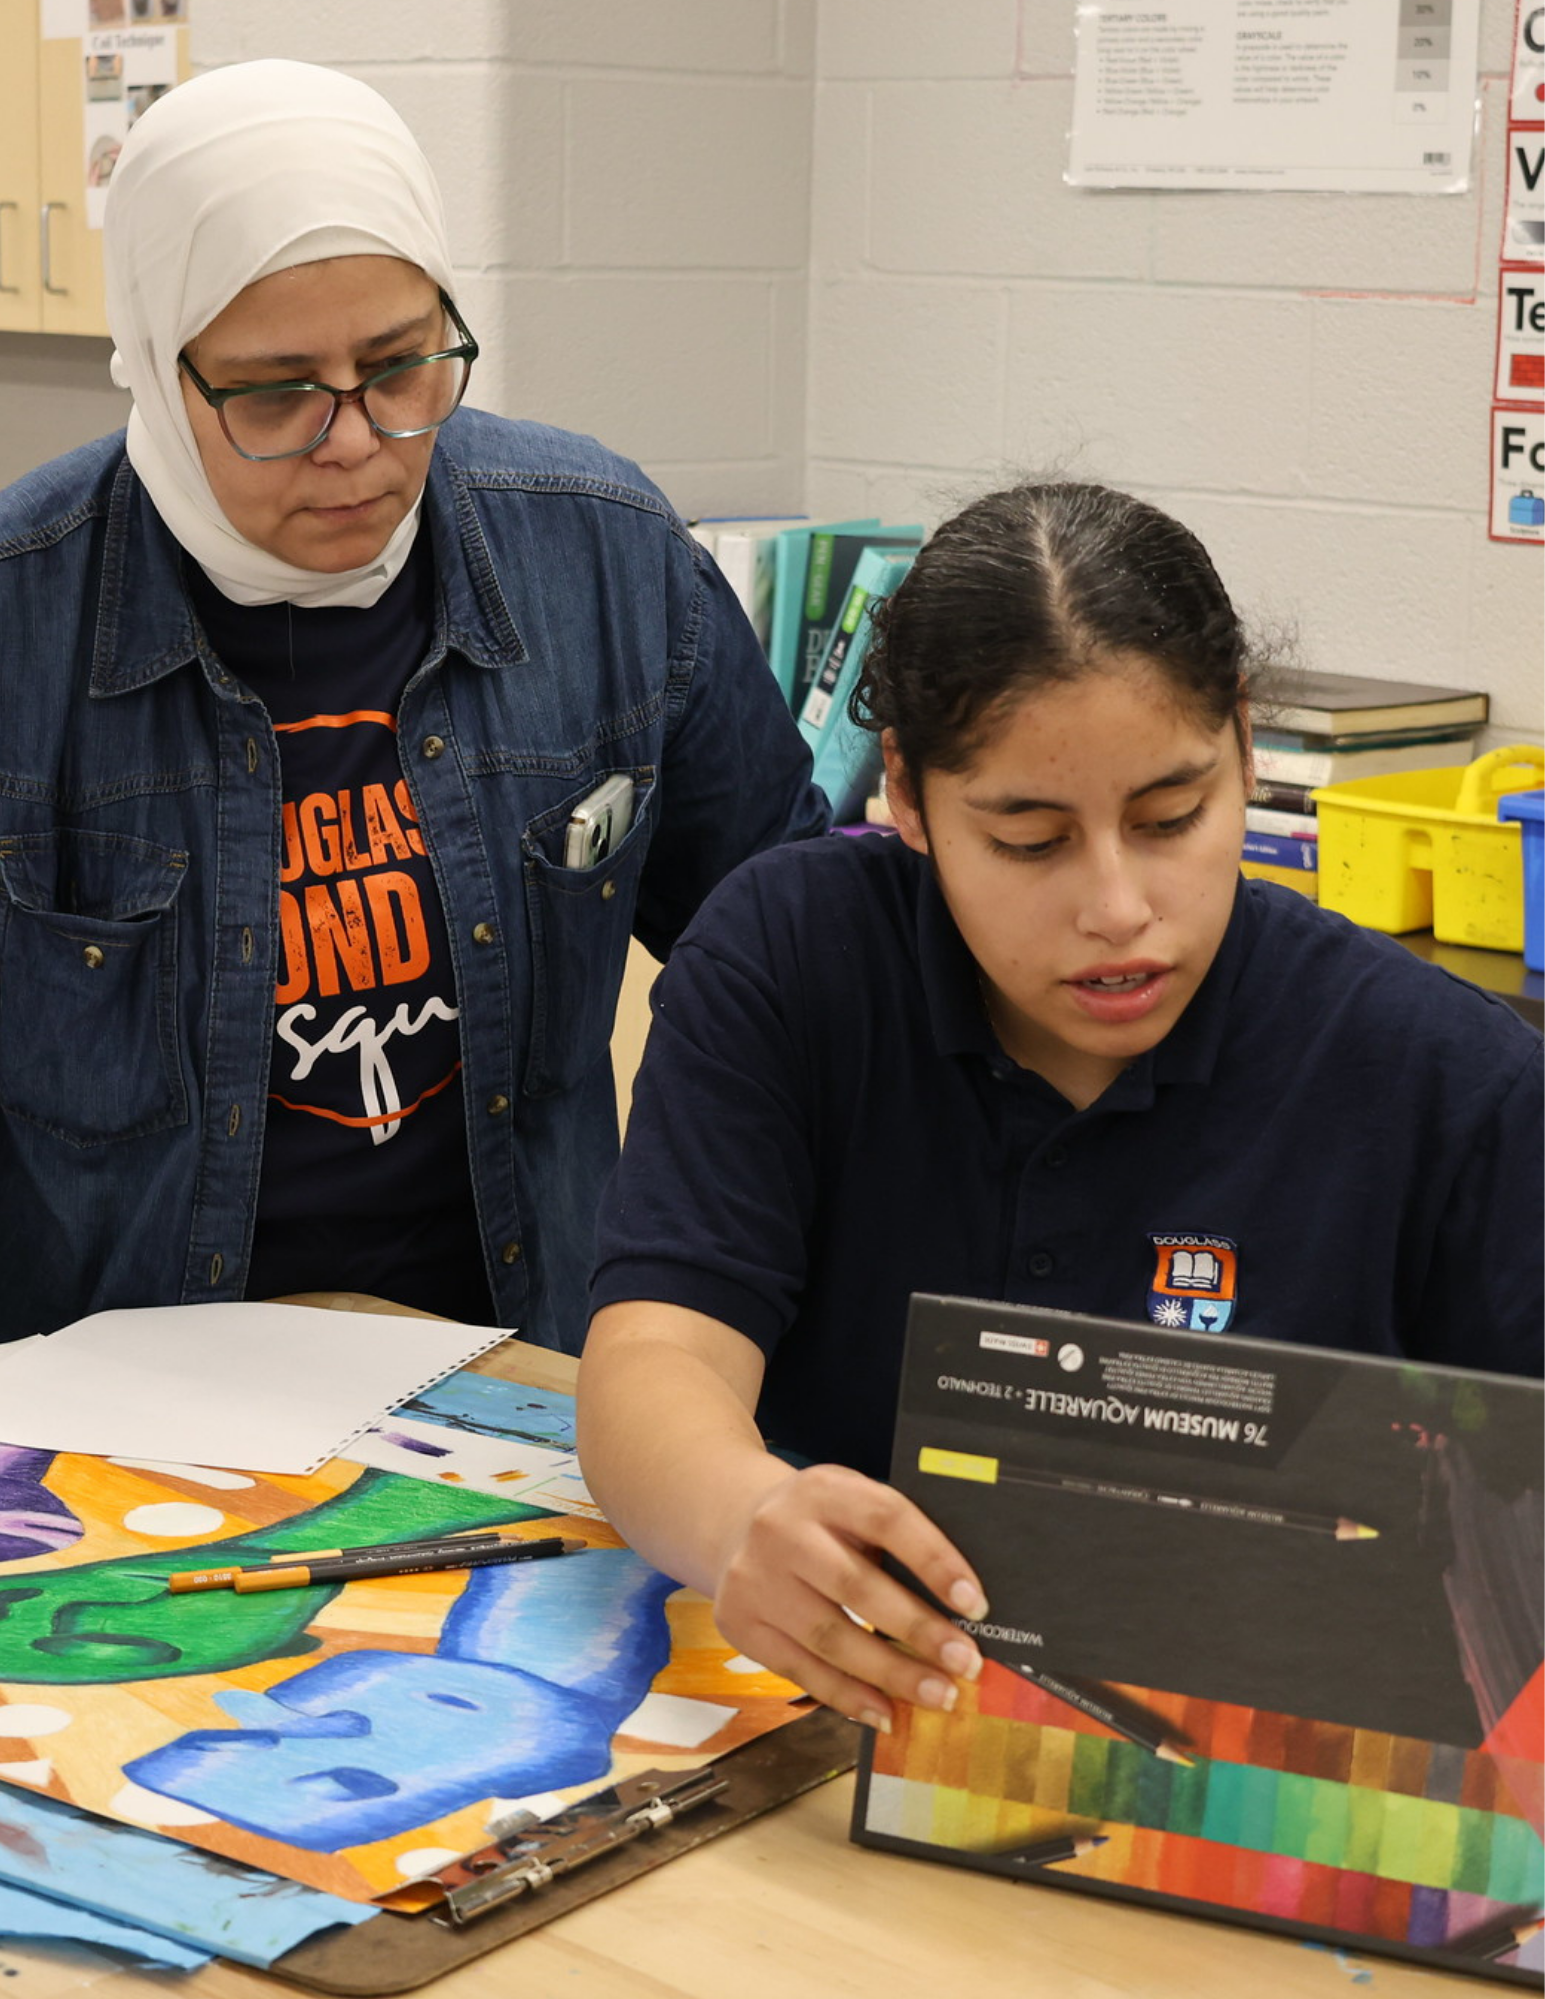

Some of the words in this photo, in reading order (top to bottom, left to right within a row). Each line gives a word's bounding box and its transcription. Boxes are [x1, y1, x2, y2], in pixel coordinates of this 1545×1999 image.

[1099, 14, 1133, 22] TERTIARY
[1136, 14, 1166, 22] COLORS
[1236, 31, 1282, 40] GRAYSCALE
[1413, 37, 1433, 48] 20%
[1412, 70, 1431, 80] 10%
[1413, 102, 1426, 112] 0%
[1153, 1235, 1231, 1250] DOUGLASS
[937, 1375, 1001, 1398] TECHNALO
[1004, 1385, 1014, 1400] 2
[1025, 1388, 1140, 1425] AQUARELLE
[1144, 1406, 1240, 1443] MUSEUM
[1243, 1422, 1269, 1447] 76
[1039, 1674, 1080, 1702] AQUARELLE
[1080, 1697, 1114, 1721] MUSEUM
